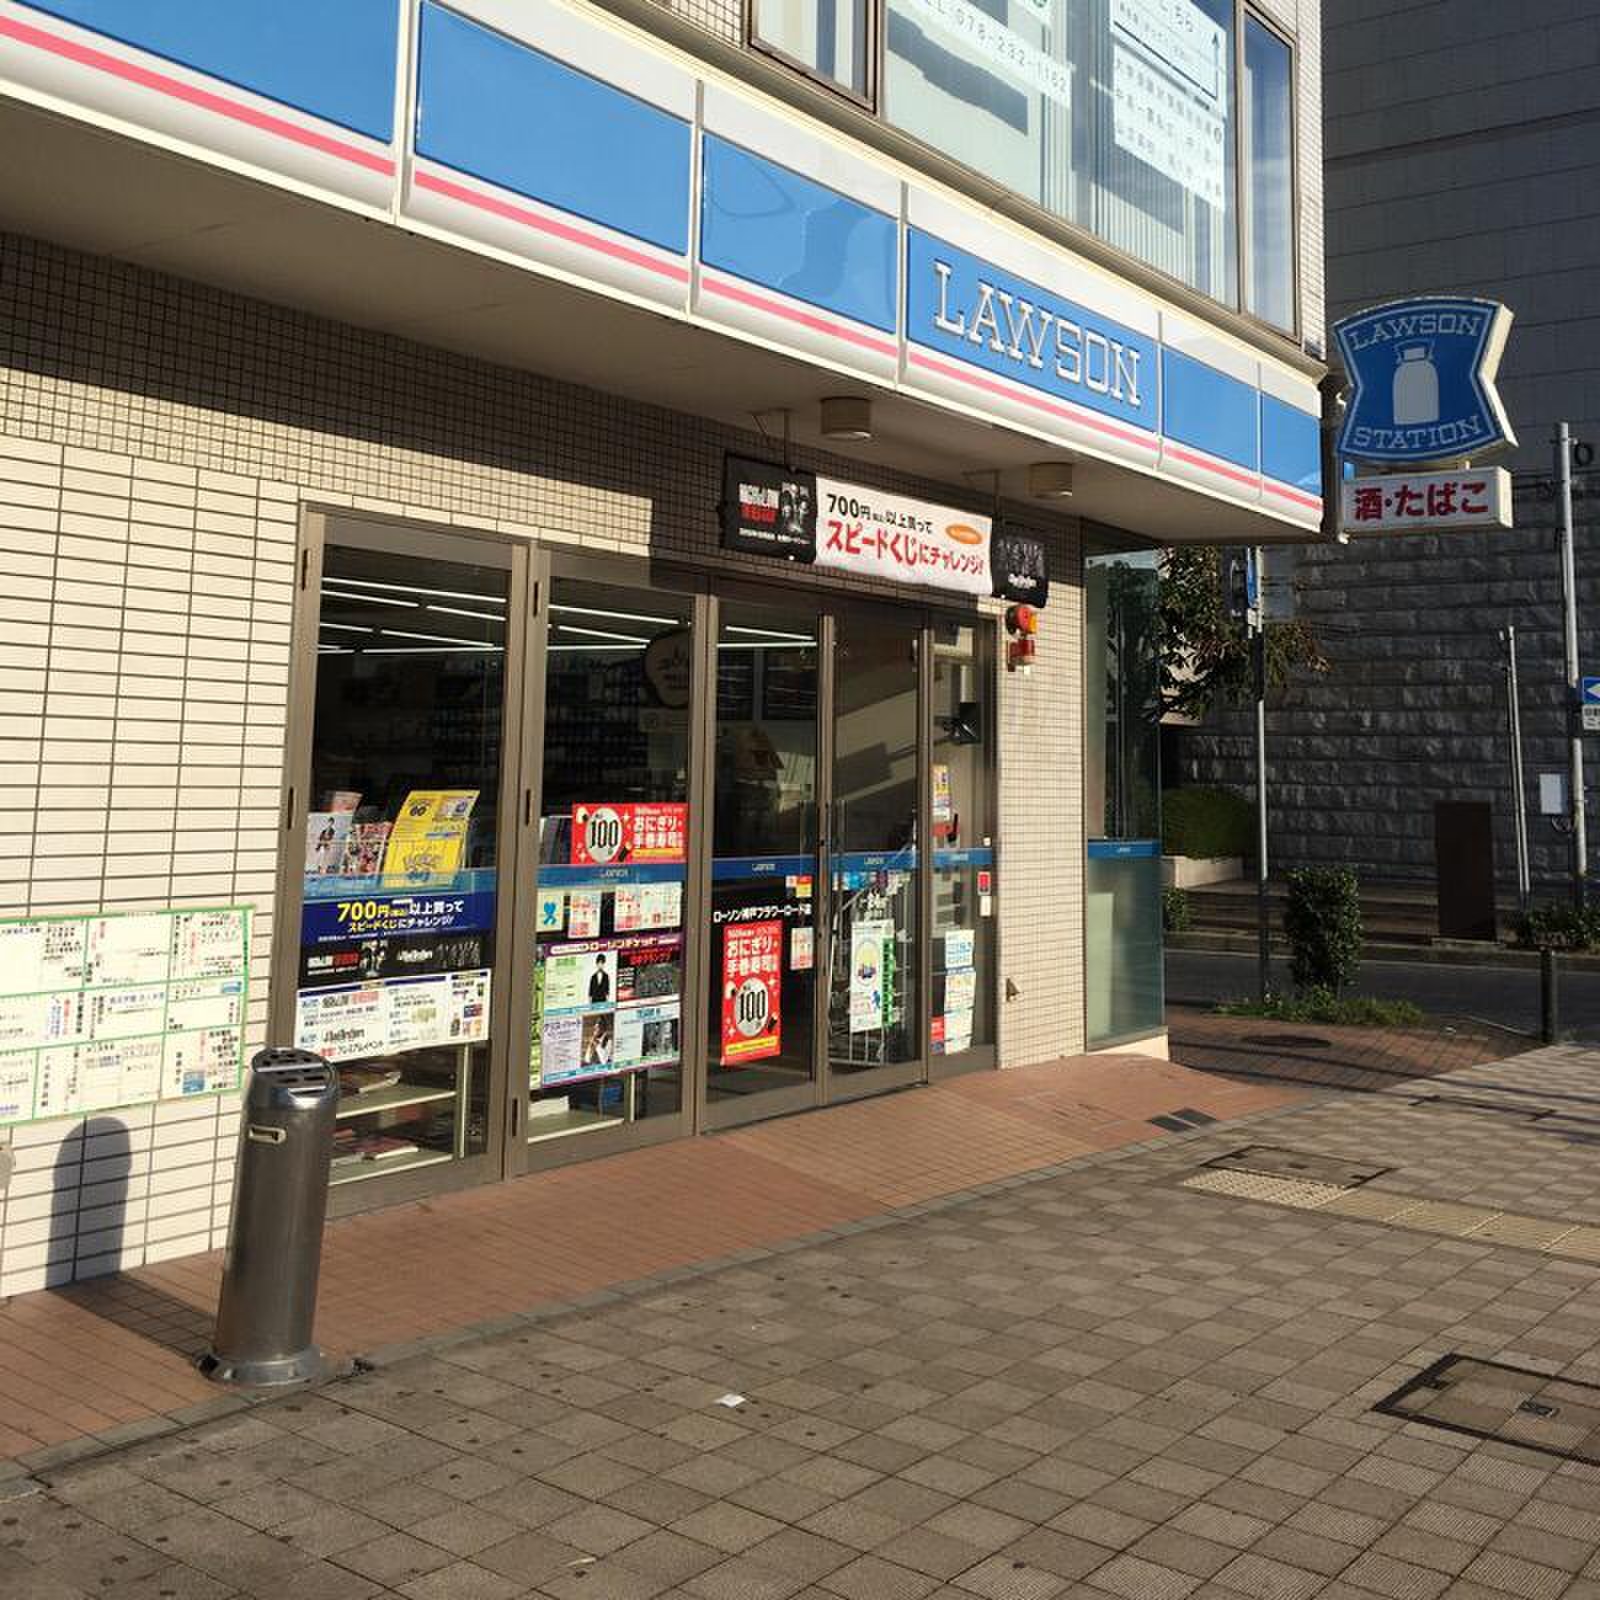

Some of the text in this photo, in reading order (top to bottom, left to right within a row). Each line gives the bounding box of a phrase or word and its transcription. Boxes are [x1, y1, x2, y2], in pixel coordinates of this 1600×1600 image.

[934, 261, 1141, 407] LAWSON
[1350, 314, 1482, 350] LAWSON
[1353, 415, 1481, 449] STATION
[1354, 481, 1489, 522] 酒・たばこ
